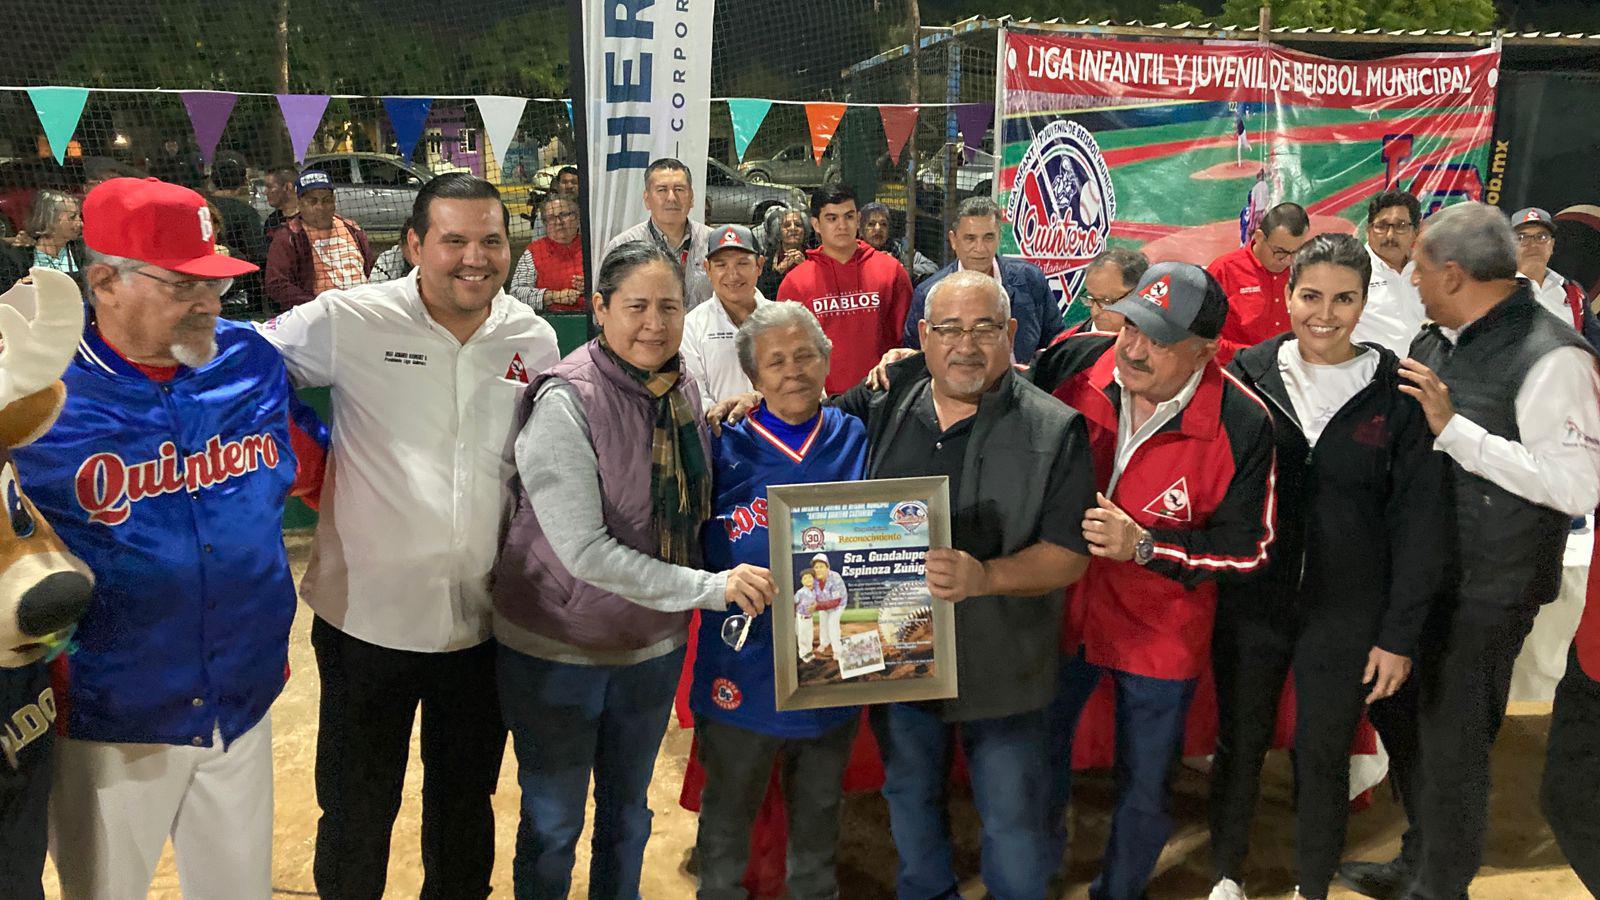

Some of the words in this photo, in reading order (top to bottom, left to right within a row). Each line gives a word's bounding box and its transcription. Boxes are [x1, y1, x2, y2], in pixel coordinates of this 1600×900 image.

[604, 0, 656, 171] HER
[671, 0, 689, 132] CORPOR
[1027, 45, 1074, 81] LIGA
[1078, 48, 1170, 86] INFANTIL
[1174, 54, 1188, 86] Y
[1188, 55, 1267, 95] JUVENIL
[1270, 57, 1291, 92] DE
[1293, 62, 1363, 97] BEISBOL
[1365, 65, 1473, 98] MUNICIPAL
[1487, 139, 1509, 206] ob.mx
[1020, 208, 1104, 257] Quintero
[812, 294, 880, 313] DIABLOS
[75, 433, 280, 527] Quintero
[807, 533, 819, 543] 30
[838, 532, 902, 544] Reconocimiento
[843, 552, 866, 564] Sra.
[868, 549, 926, 562] Guadalupe
[841, 565, 891, 578] Espinoza
[893, 562, 928, 575] Zúñig
